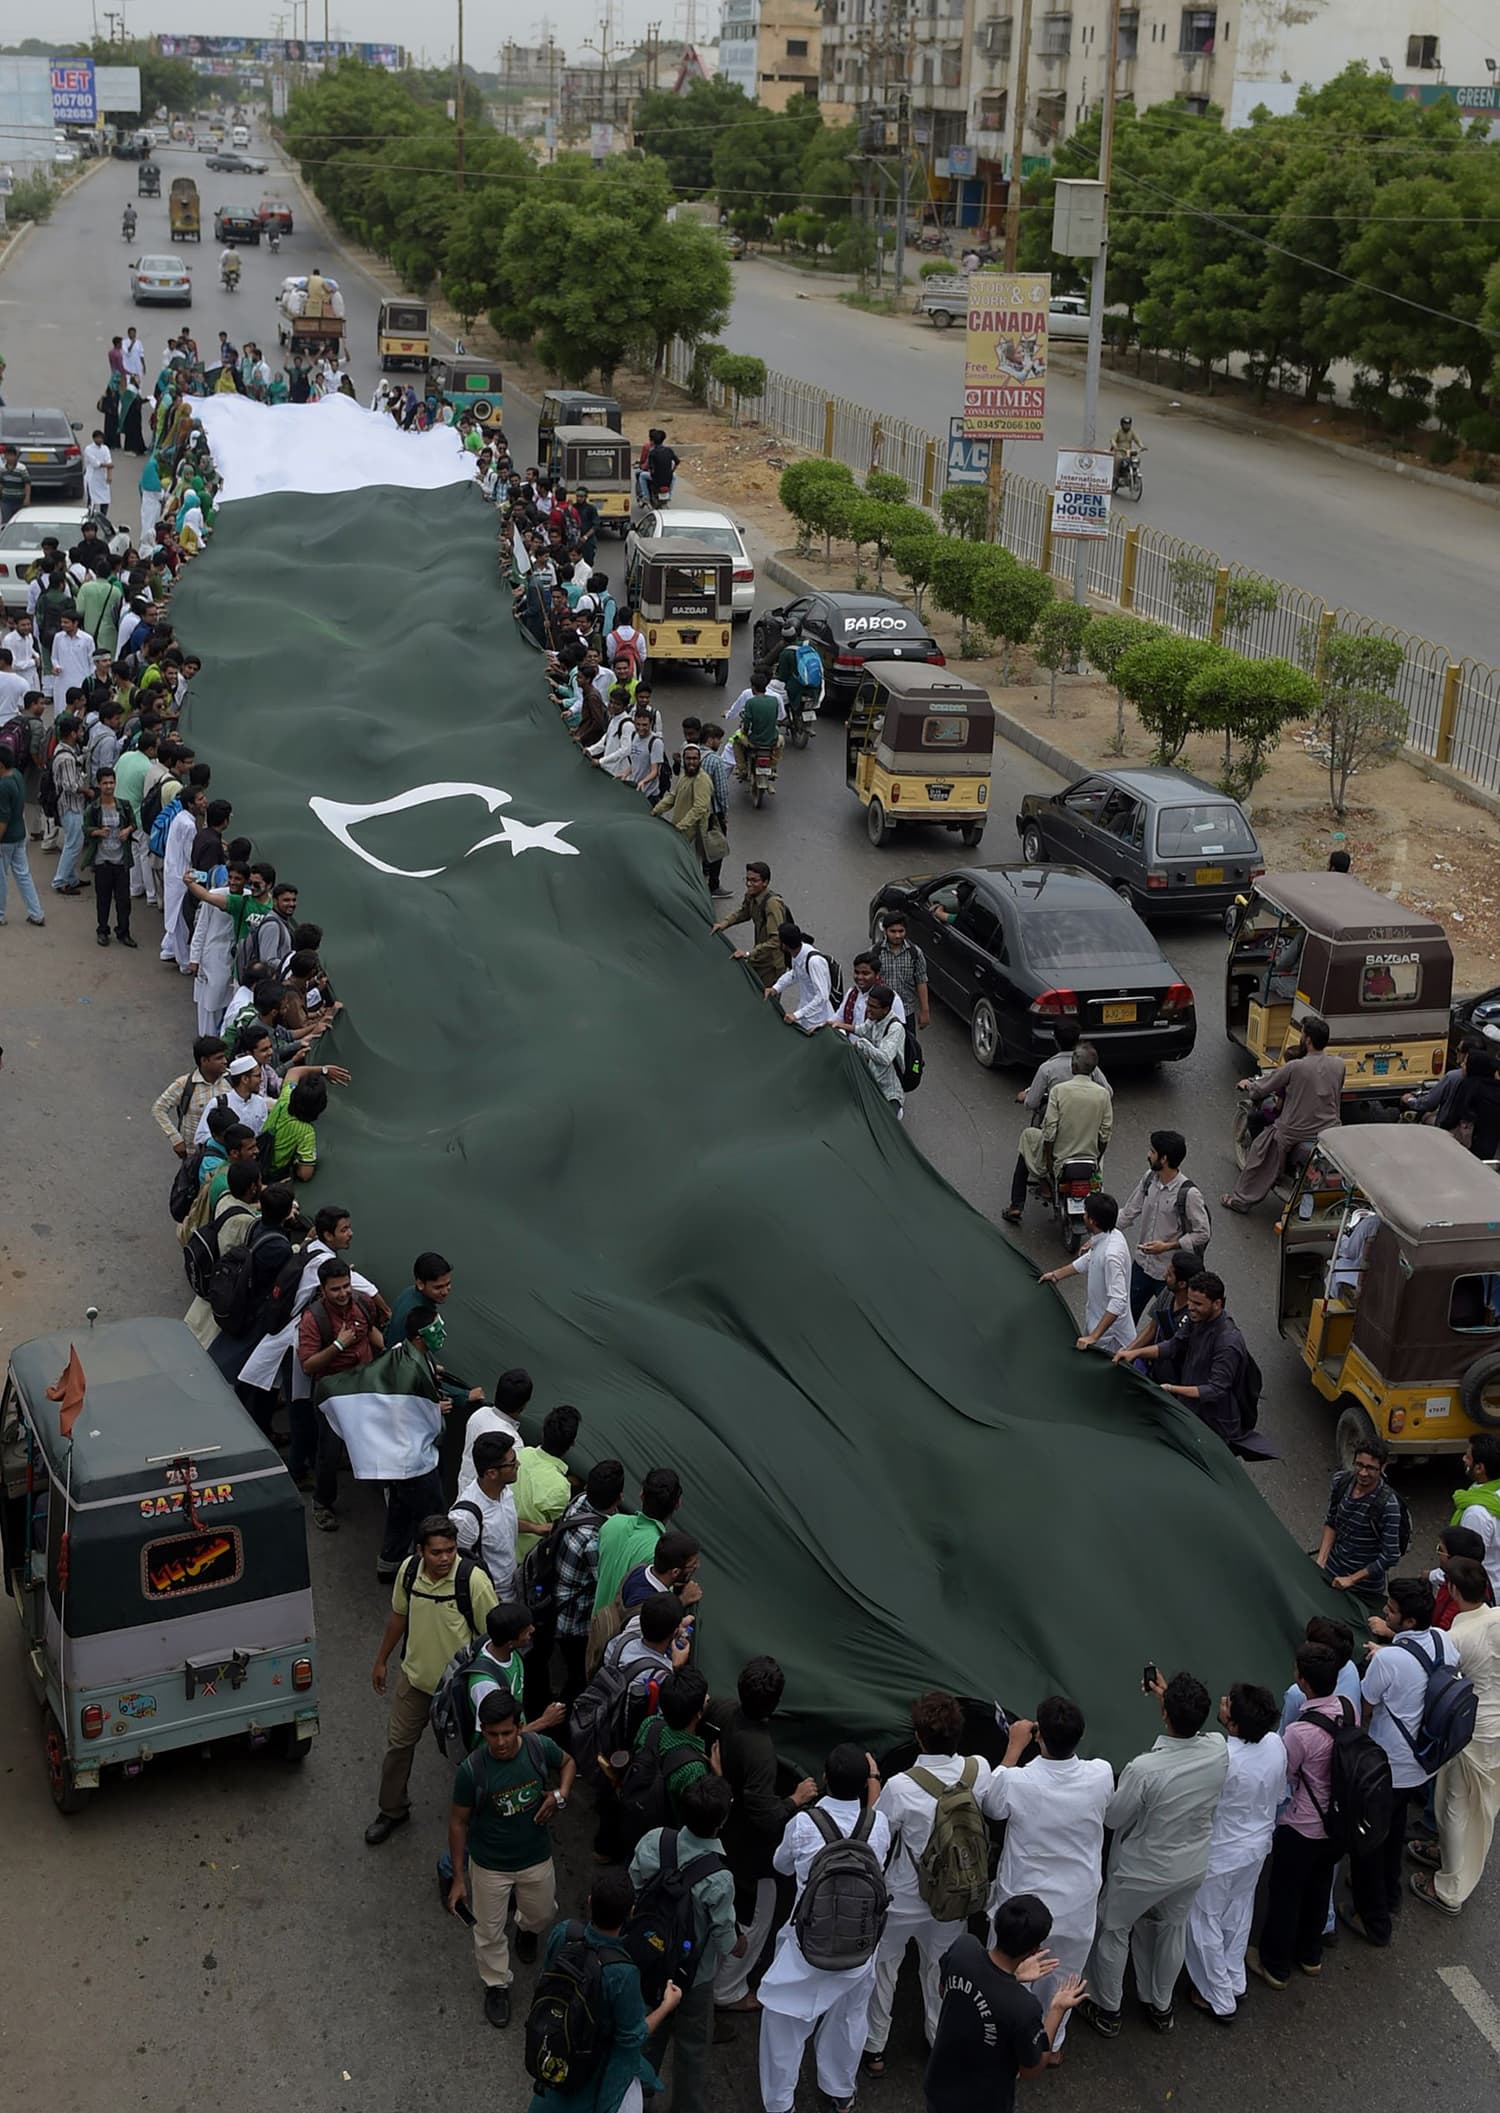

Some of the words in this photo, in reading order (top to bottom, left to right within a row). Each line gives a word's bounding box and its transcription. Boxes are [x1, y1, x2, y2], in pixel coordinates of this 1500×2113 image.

[53, 70, 90, 91] LET
[1456, 88, 1495, 108] GREEN
[969, 296, 1008, 306] WORK
[1010, 286, 1025, 305] &
[968, 310, 1047, 333] CANADA
[965, 361, 988, 372] Free
[983, 389, 1043, 408] TIMES
[949, 442, 989, 470] A/C
[1060, 474, 1108, 484] International
[1063, 492, 1103, 506] OPEN
[1056, 503, 1107, 518] HOUSE
[1365, 952, 1420, 965] SAZGAR
[948, 1975, 973, 1995] LEAD
[973, 1990, 993, 2019] THE
[984, 2022, 998, 2047] WAY
